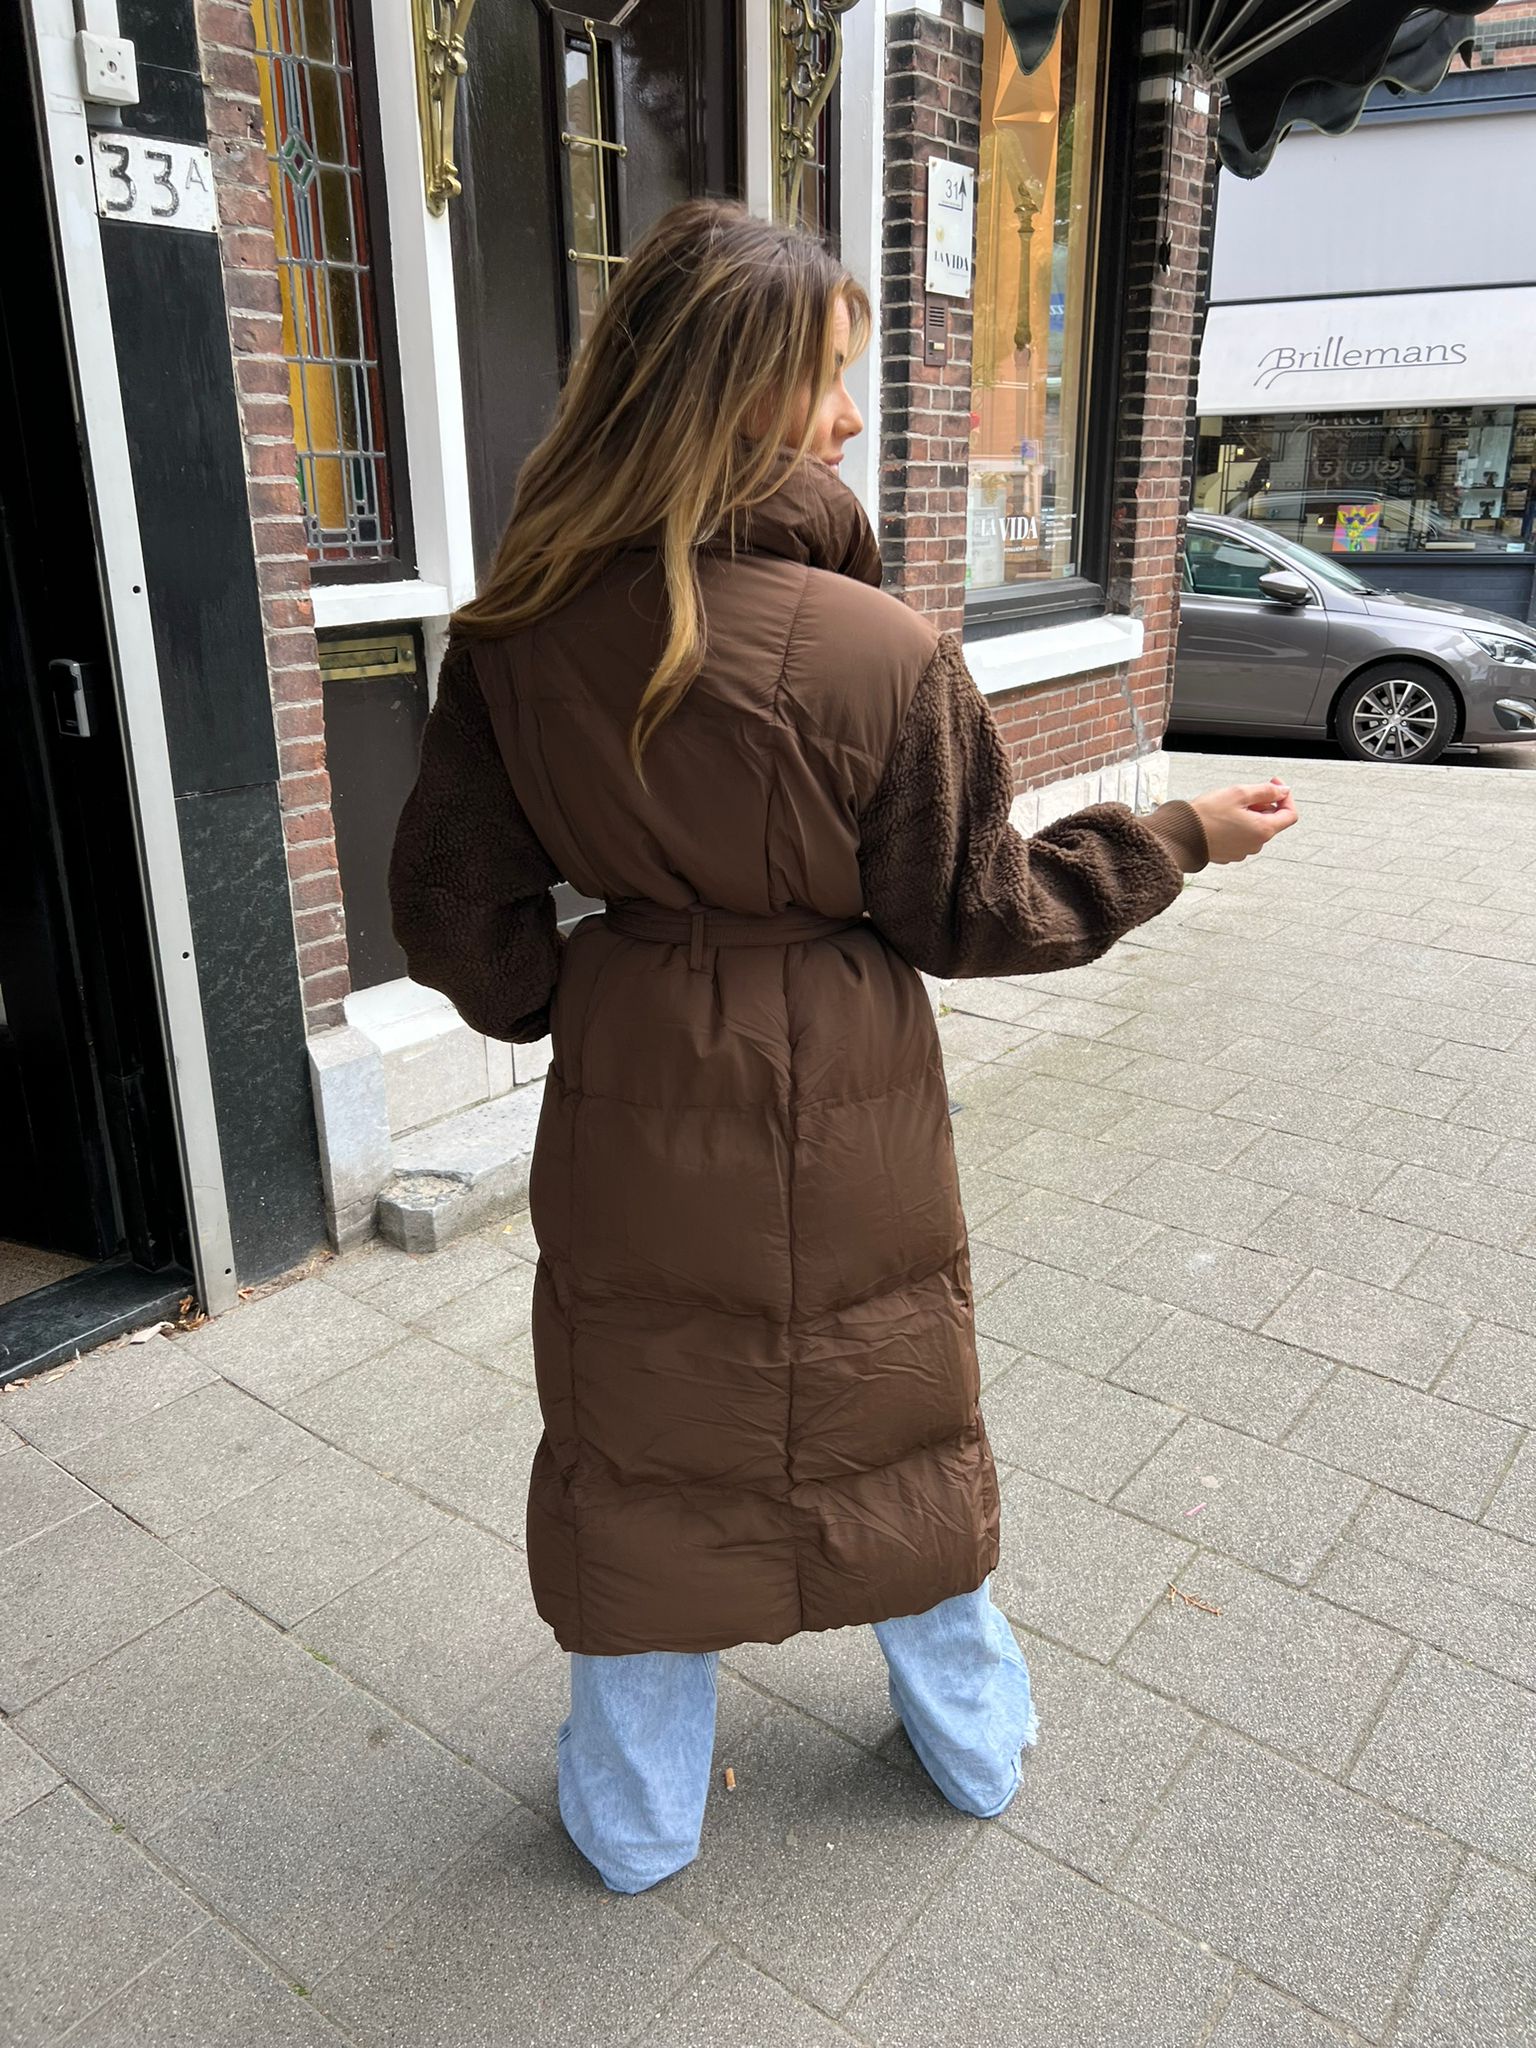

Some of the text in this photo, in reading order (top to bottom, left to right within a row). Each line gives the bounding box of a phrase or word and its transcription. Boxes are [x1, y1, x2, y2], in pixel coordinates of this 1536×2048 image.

[945, 178, 958, 200] 31
[945, 252, 969, 272] VIDA
[1254, 336, 1467, 389] Brillemans
[1380, 461, 1400, 473] 25
[981, 518, 996, 537] LA
[999, 516, 1038, 541] VIDA
